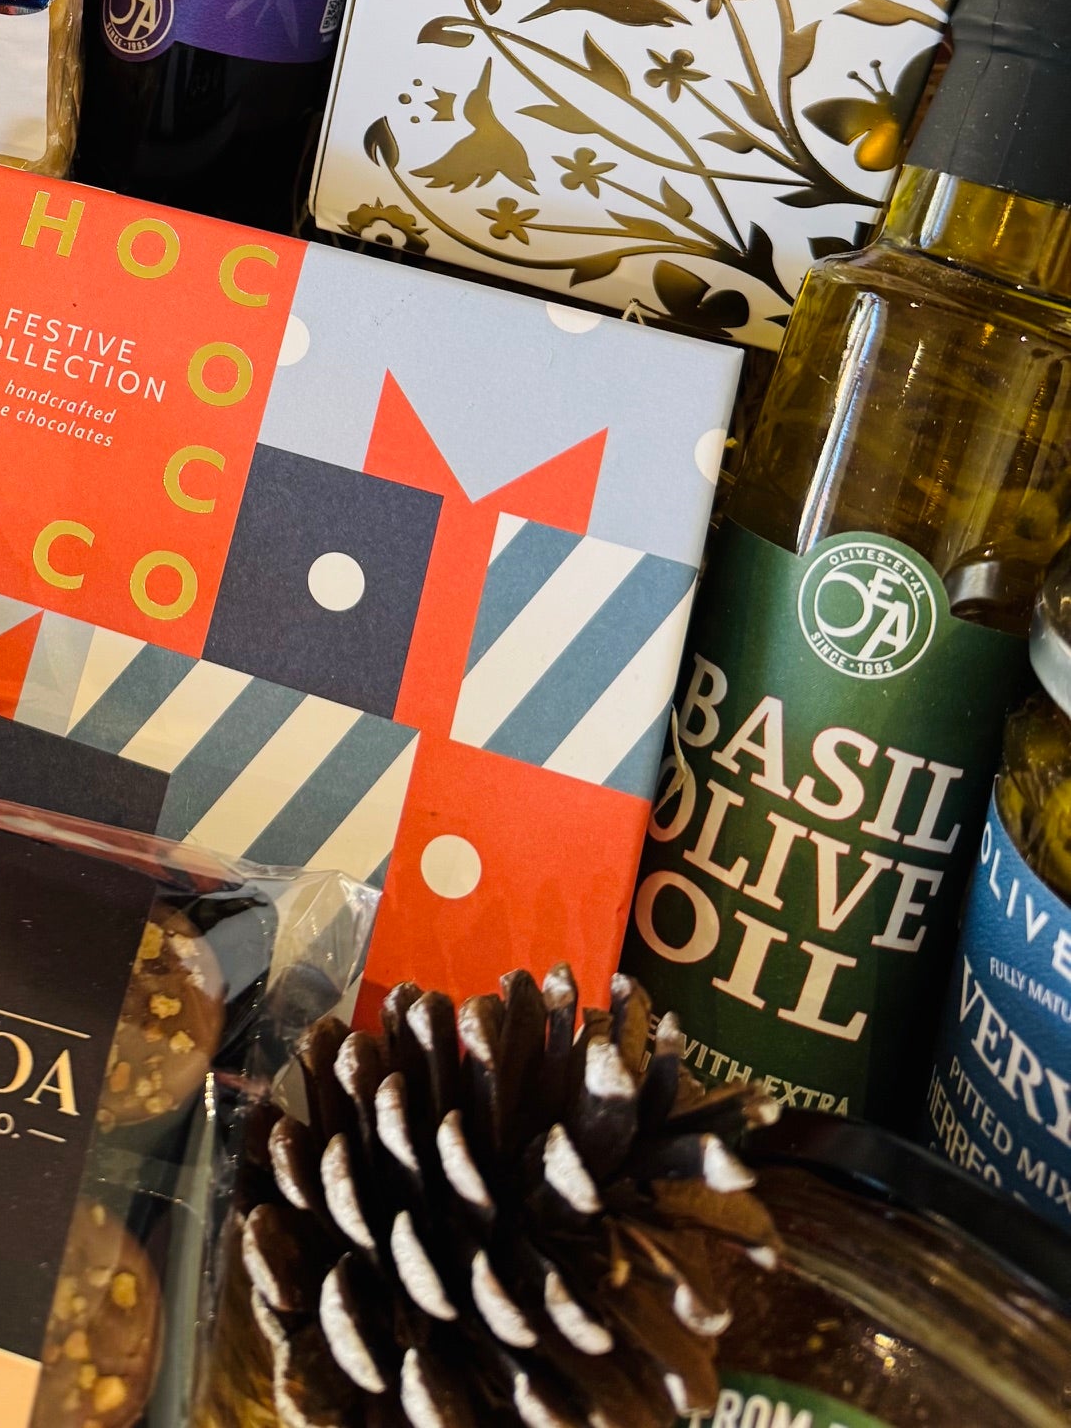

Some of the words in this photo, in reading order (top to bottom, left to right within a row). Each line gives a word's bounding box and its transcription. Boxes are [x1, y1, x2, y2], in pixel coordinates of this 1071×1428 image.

[4, 307, 137, 364] FESTIVE
[5, 379, 118, 425] handcrafted
[16, 409, 114, 448] chocolates
[810, 631, 847, 669] SINCE
[676, 652, 964, 855] BASIL
[646, 754, 944, 953] OLIVE
[634, 870, 868, 1043] OIL
[989, 956, 1027, 993] FULLY
[950, 1055, 1013, 1156] PITTED
